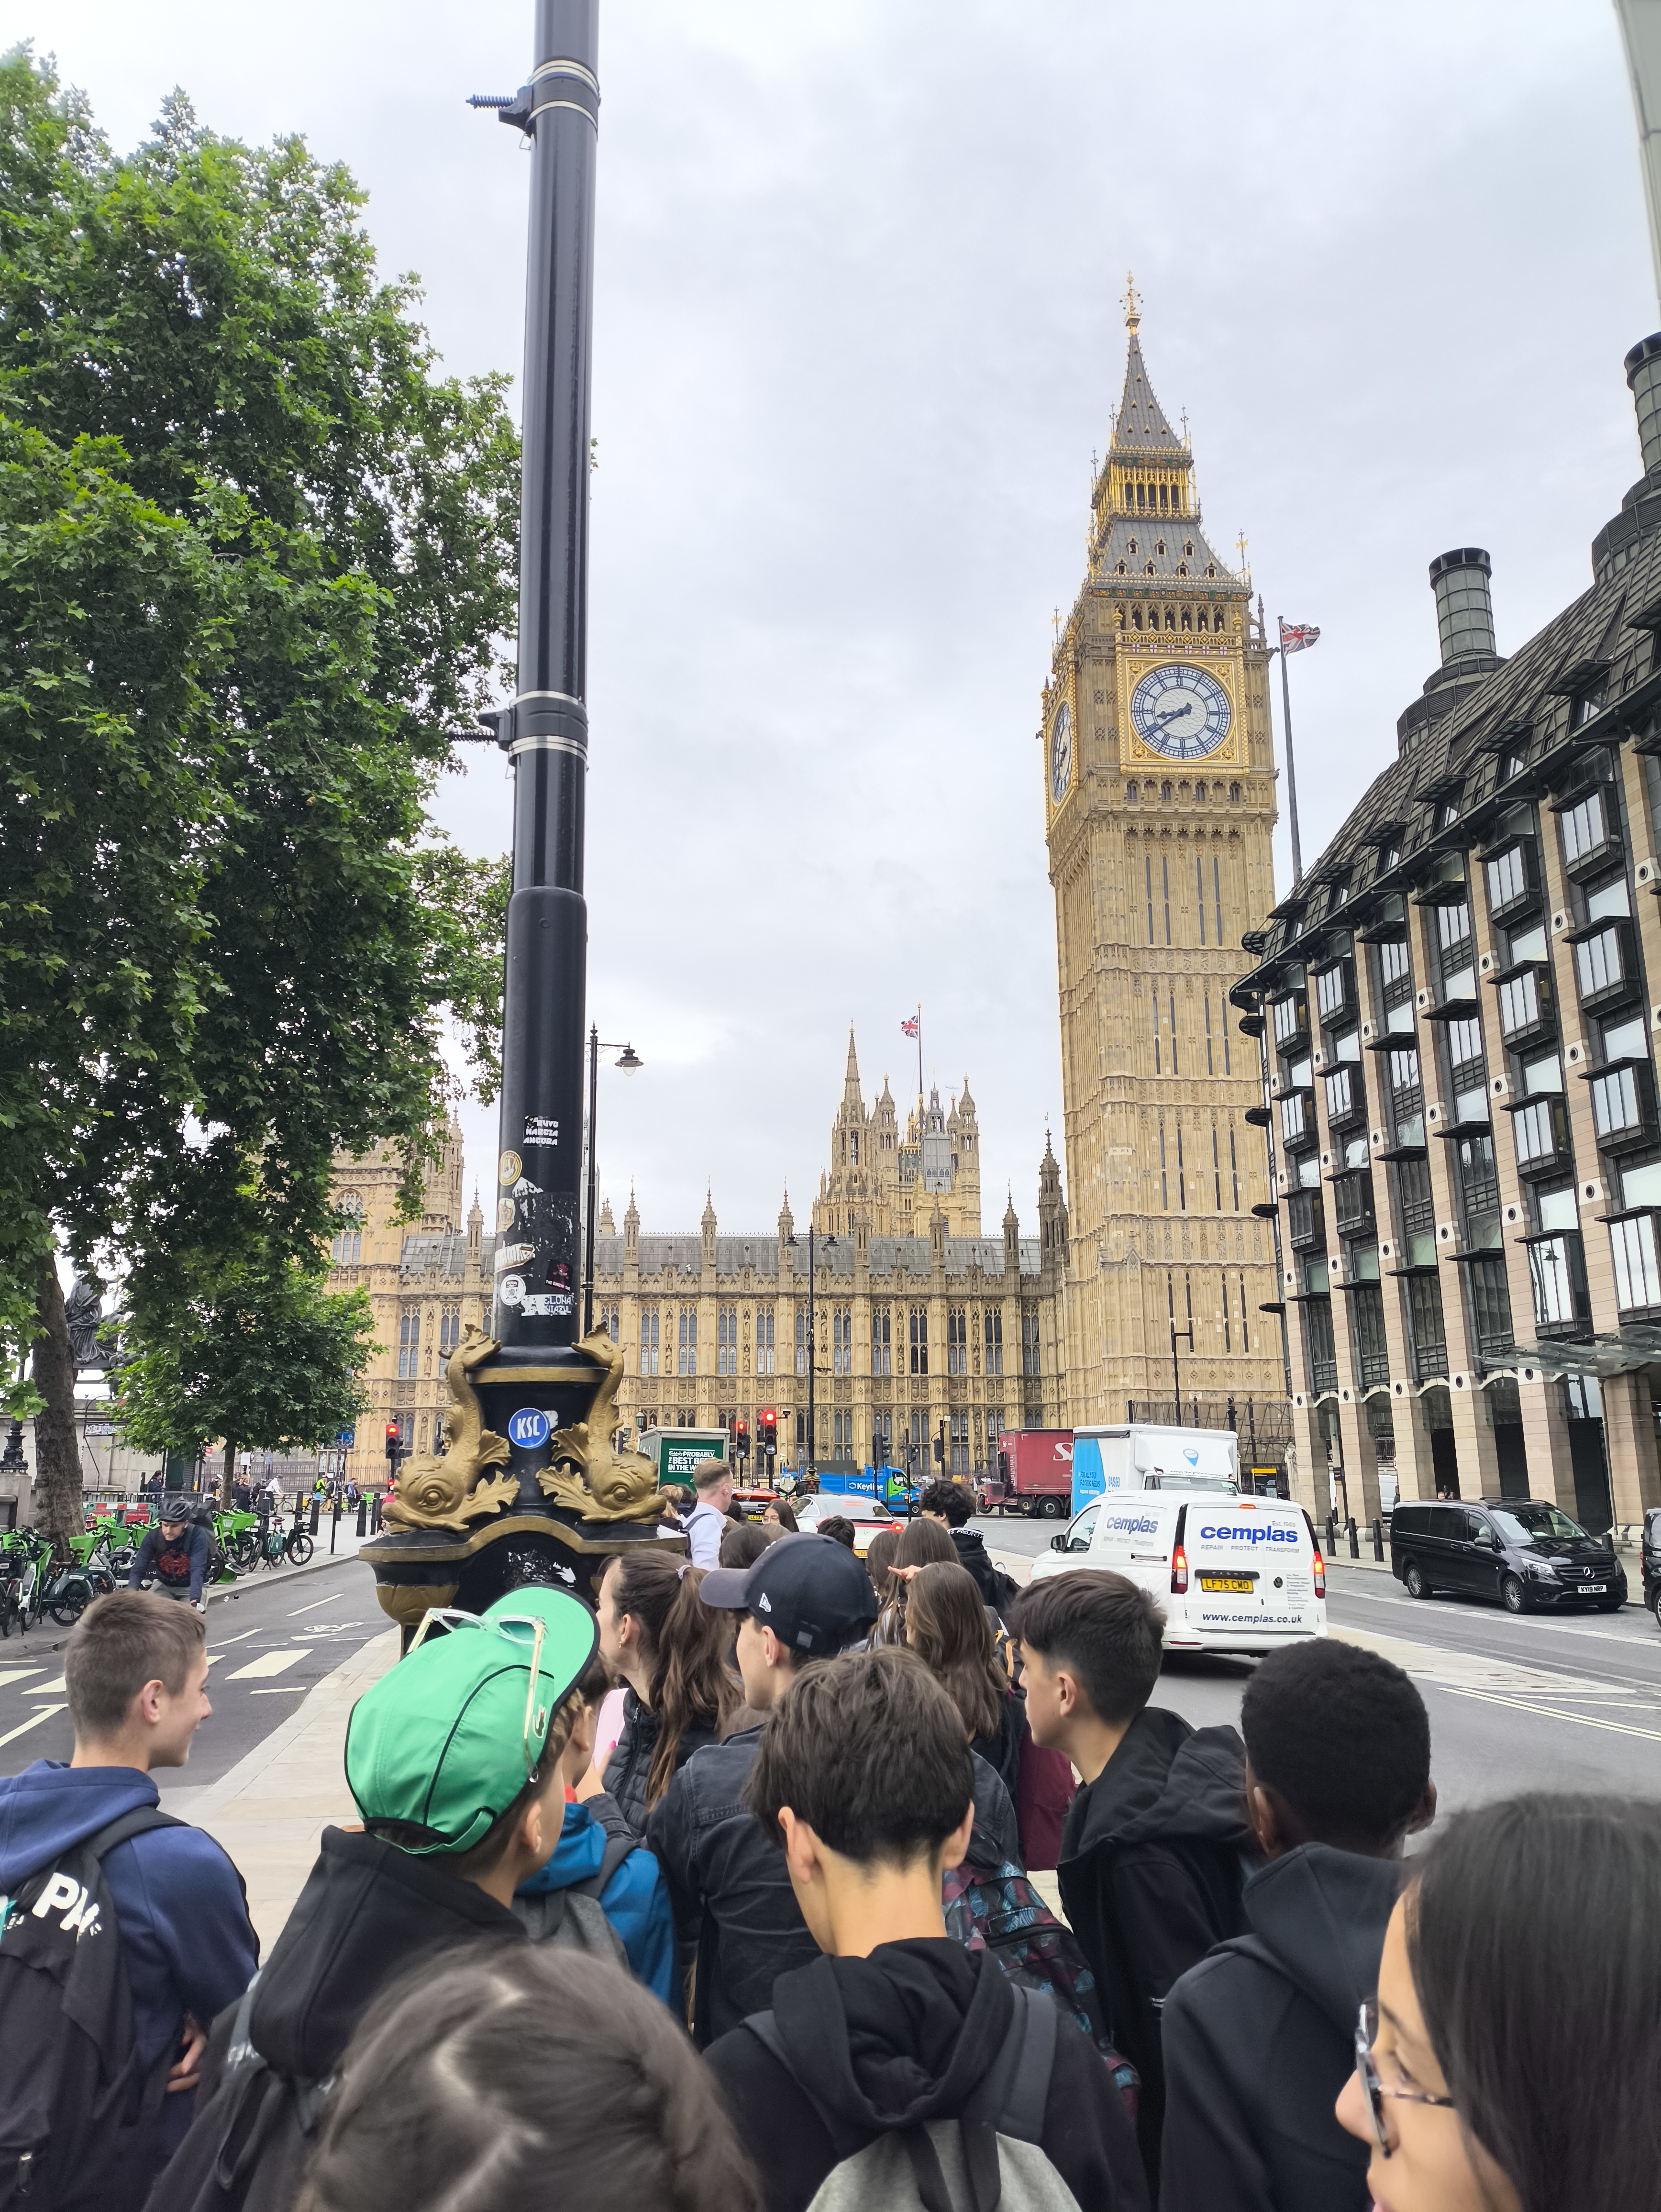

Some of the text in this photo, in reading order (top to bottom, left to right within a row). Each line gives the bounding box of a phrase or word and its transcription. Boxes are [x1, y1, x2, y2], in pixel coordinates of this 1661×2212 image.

[526, 1128, 558, 1137] MARCIA
[523, 1137, 558, 1146] ANCORA
[517, 1415, 540, 1439] KSC
[1107, 1515, 1158, 1535] cemplas
[1200, 1525, 1298, 1544] cemplas
[1205, 1579, 1230, 1589] LF75
[1202, 1614, 1303, 1624] www.cemplas.co.uk
